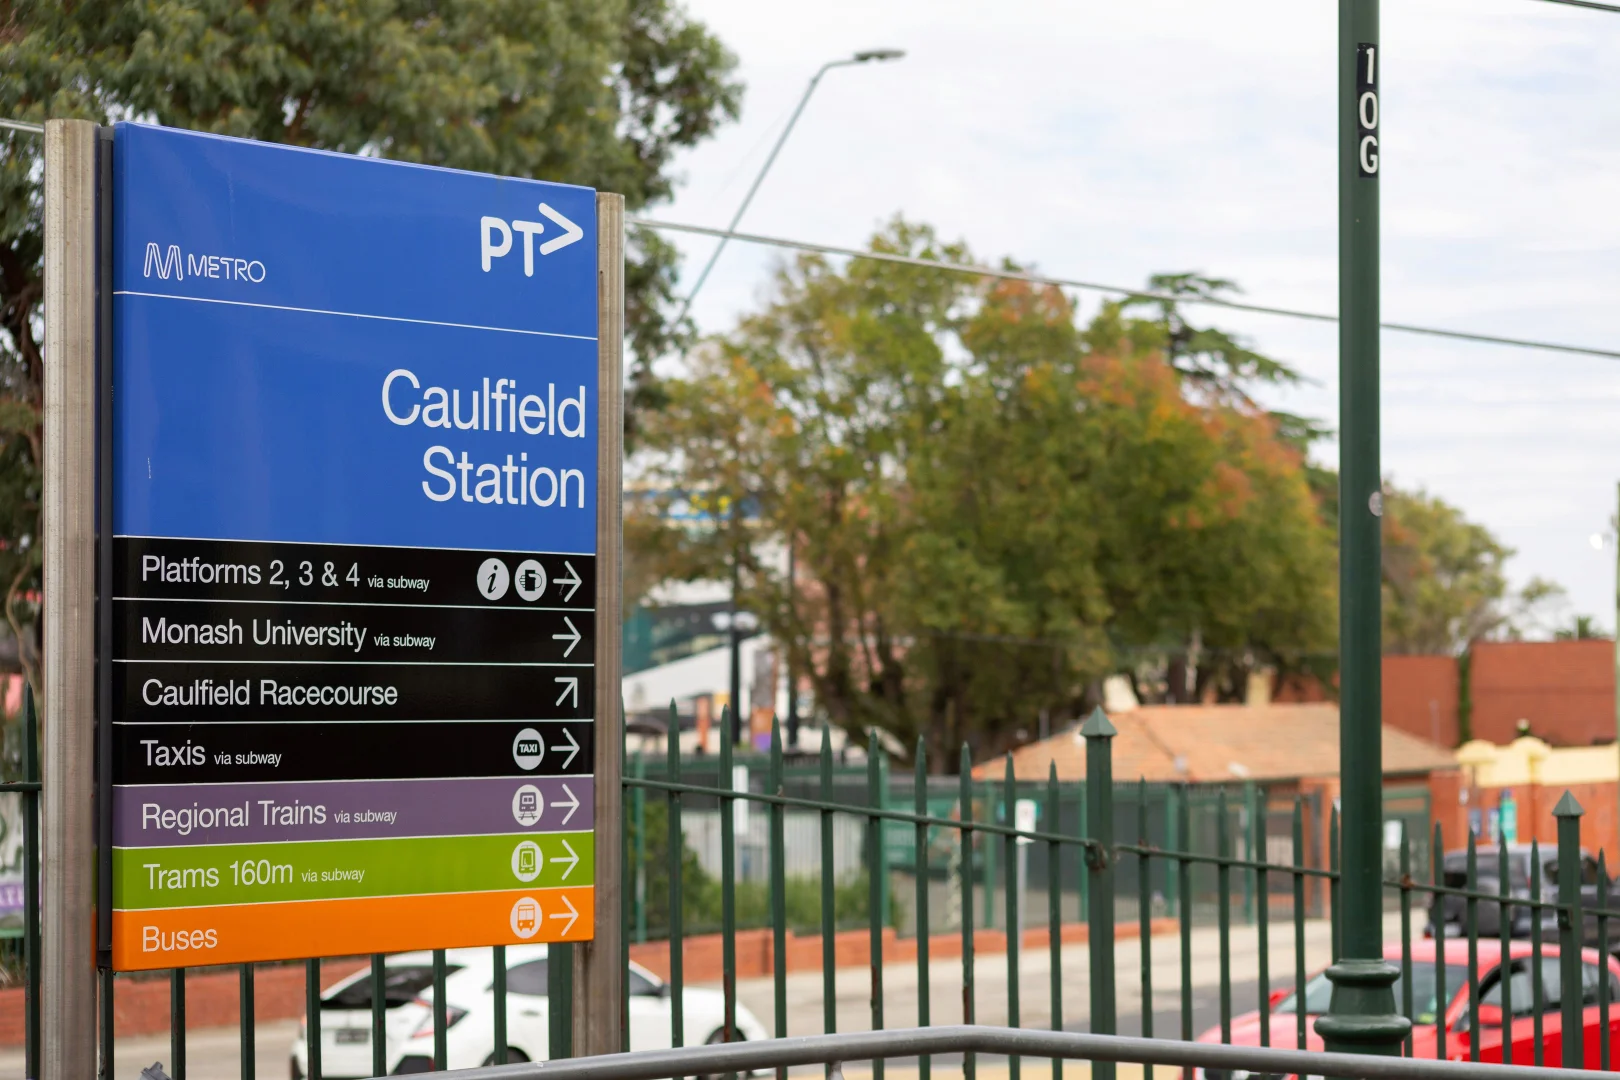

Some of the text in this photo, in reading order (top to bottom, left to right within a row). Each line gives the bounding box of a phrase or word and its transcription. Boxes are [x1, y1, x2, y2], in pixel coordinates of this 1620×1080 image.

[188, 253, 266, 283] METRO
[381, 368, 586, 439] Caulfield
[421, 445, 585, 509] Station
[142, 554, 430, 593] Platforms 2, 3 & 4 via subway
[142, 616, 436, 653] Monash University via subway
[142, 678, 398, 706] Caulfield Racecourse
[139, 739, 282, 768] Taxis via subway
[518, 743, 538, 754] TAXI
[142, 799, 398, 836] Regional Trains via subway
[142, 859, 365, 890] Trams 160m via subway
[142, 925, 218, 953] Buses
